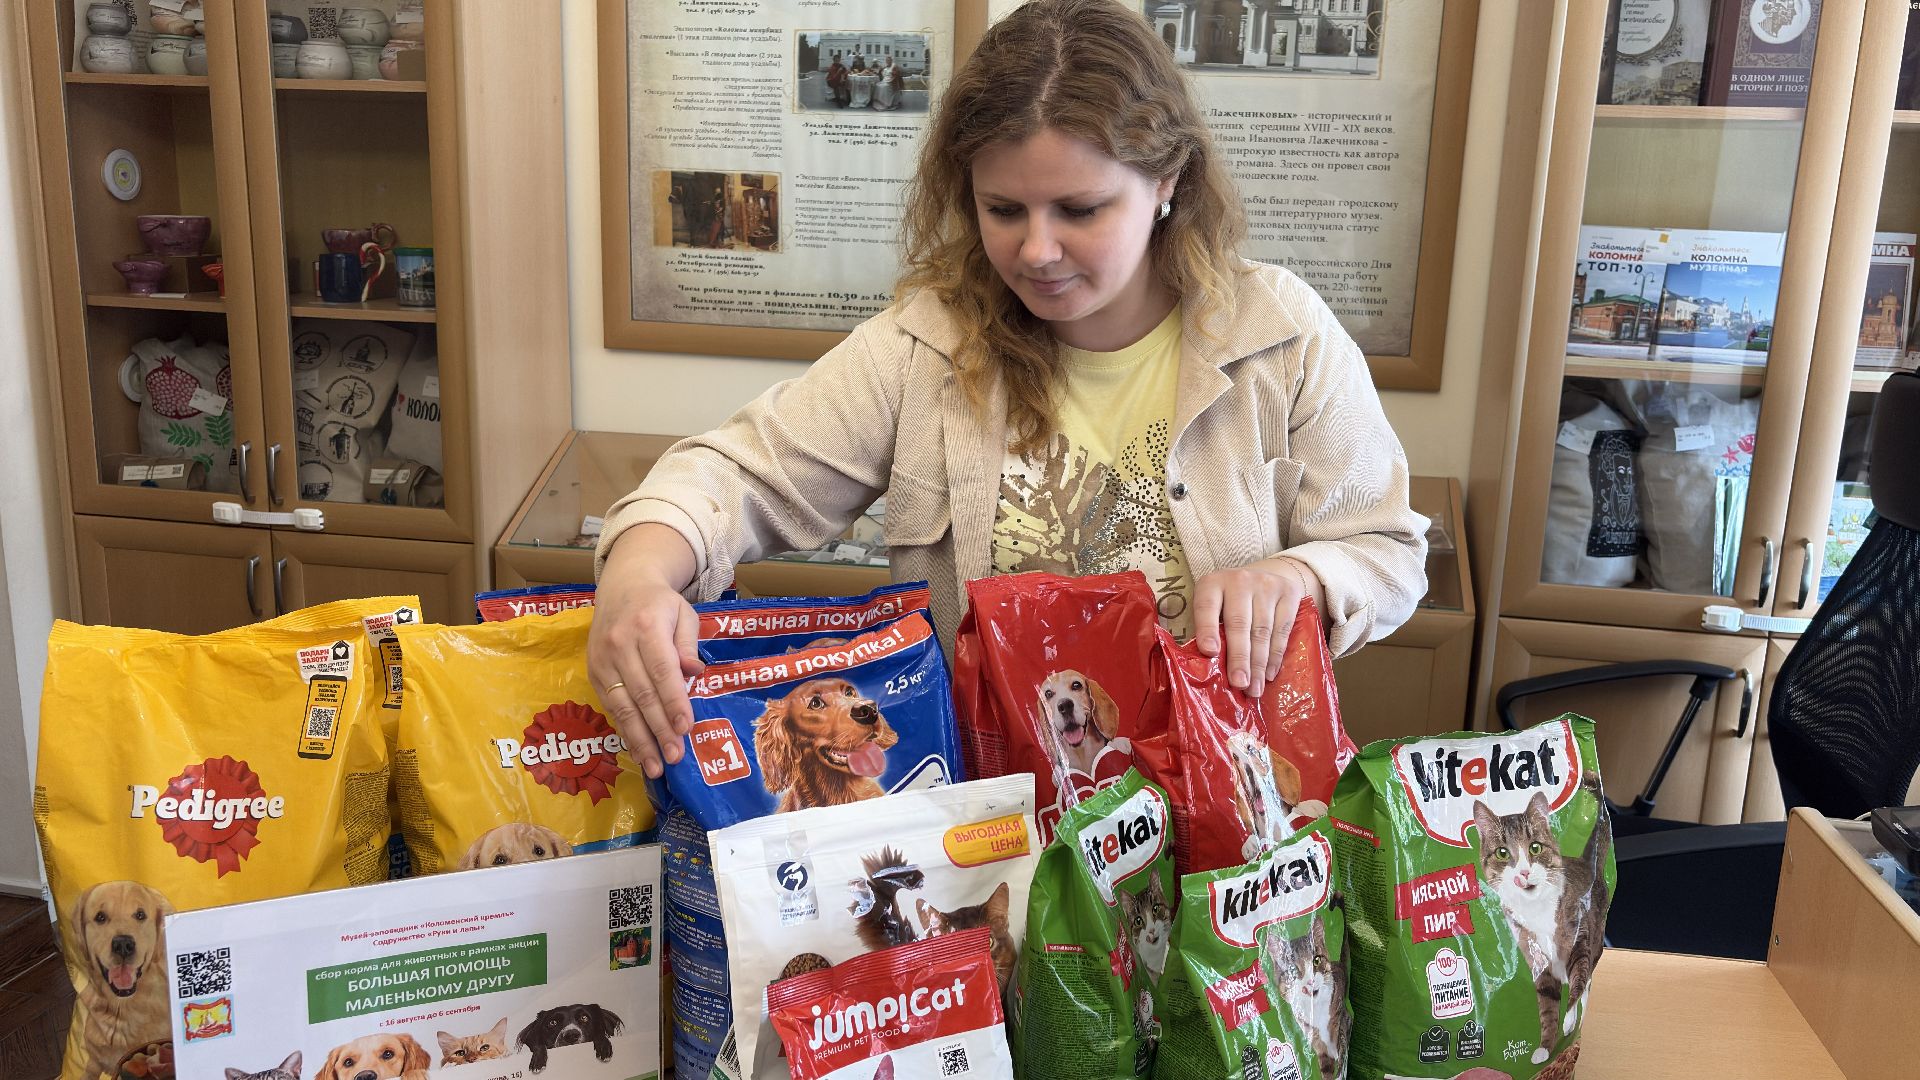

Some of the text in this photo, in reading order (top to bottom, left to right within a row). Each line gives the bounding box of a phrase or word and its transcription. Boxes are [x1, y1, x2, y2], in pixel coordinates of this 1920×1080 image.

[1731, 73, 1805, 83] В ОДНОМ ЛИЦЕ
[1730, 83, 1773, 93] ИСТОРИК
[1775, 84, 1783, 93] И
[1209, 109, 1392, 122] Лажечниковых» исторический и
[1250, 123, 1396, 134] середины XVIII XIX веков.
[1214, 134, 1379, 146] Ивана Ивановича Лажечникова
[1227, 148, 1276, 158] широкую
[1279, 149, 1341, 158] известность
[1344, 150, 1362, 159] как
[1364, 151, 1400, 161] автора
[1236, 159, 1391, 172] романа. Здесь он провел свои
[1291, 173, 1319, 182] годы.
[1270, 196, 1399, 211] был передан городскому
[1269, 210, 1382, 222] литературного музея.
[1294, 223, 1380, 233] получила статус
[1251, 233, 1328, 243] ного значения.
[1590, 242, 1646, 252] Знакомьтесь
[1872, 243, 1911, 257] МНА
[1287, 257, 1392, 270] Всероссийского Дня
[1588, 251, 1644, 262] КОЛОМНА
[1690, 254, 1748, 264] КОЛОМНА
[1588, 261, 1643, 274] ТОП-10
[1689, 263, 1748, 273] МУЗЕЙНАЯ
[1304, 271, 1379, 282] начала работу
[703, 286, 734, 294] работы
[773, 289, 817, 298] филиалов:
[827, 292, 858, 302] 10.30
[1332, 283, 1382, 293] 220-летия
[690, 296, 735, 305] Выходные
[764, 301, 839, 310] понедельник,
[1336, 295, 1388, 306] музейный
[407, 396, 440, 422] КОЛО
[364, 615, 394, 625] ПОДАРИ
[714, 597, 904, 636] Удачная покупка!
[368, 621, 393, 630] ЗАБОТУ
[300, 649, 330, 658] ПОДАРИ
[794, 628, 905, 676] покупка!
[302, 656, 329, 664] ЗАБОТУ
[885, 673, 925, 695] 2,5 кг
[695, 727, 731, 745] БРЕНД
[703, 740, 744, 777] №1
[130, 784, 285, 830] Pedigree
[954, 820, 1022, 844] ВЫГОДНАЯ
[990, 838, 1023, 854] ЦЕНА
[1084, 802, 1160, 879] itekat
[1222, 844, 1325, 925] kitekat
[1411, 871, 1470, 908] МЯСНОЙ
[341, 910, 515, 943] Музей-заповедник «Коломенский кремль»
[1423, 910, 1457, 935] ПИР
[373, 933, 426, 947] Содружество
[428, 928, 451, 939] «Руки
[459, 924, 486, 934] лапы»
[315, 965, 342, 982] сбор
[344, 964, 379, 978] корма
[381, 960, 401, 972] для
[404, 951, 458, 965] животных
[468, 944, 506, 958] рамках
[508, 938, 539, 951] акции
[348, 957, 511, 992] БОЛЬШАЯ ПОМОЩЬ
[346, 973, 515, 1013] МАЛЕНЬКОМУ ДРУГУ
[1434, 987, 1469, 1004] ПИТАНИЕ
[385, 1019, 395, 1027] 16
[396, 1014, 426, 1026] августа
[426, 1012, 438, 1021] до
[445, 1004, 481, 1017] сентября
[814, 1028, 900, 1061] PREMIUM PET FOOD
[1507, 1039, 1527, 1050] Кот
[1503, 1046, 1529, 1062] Борис
